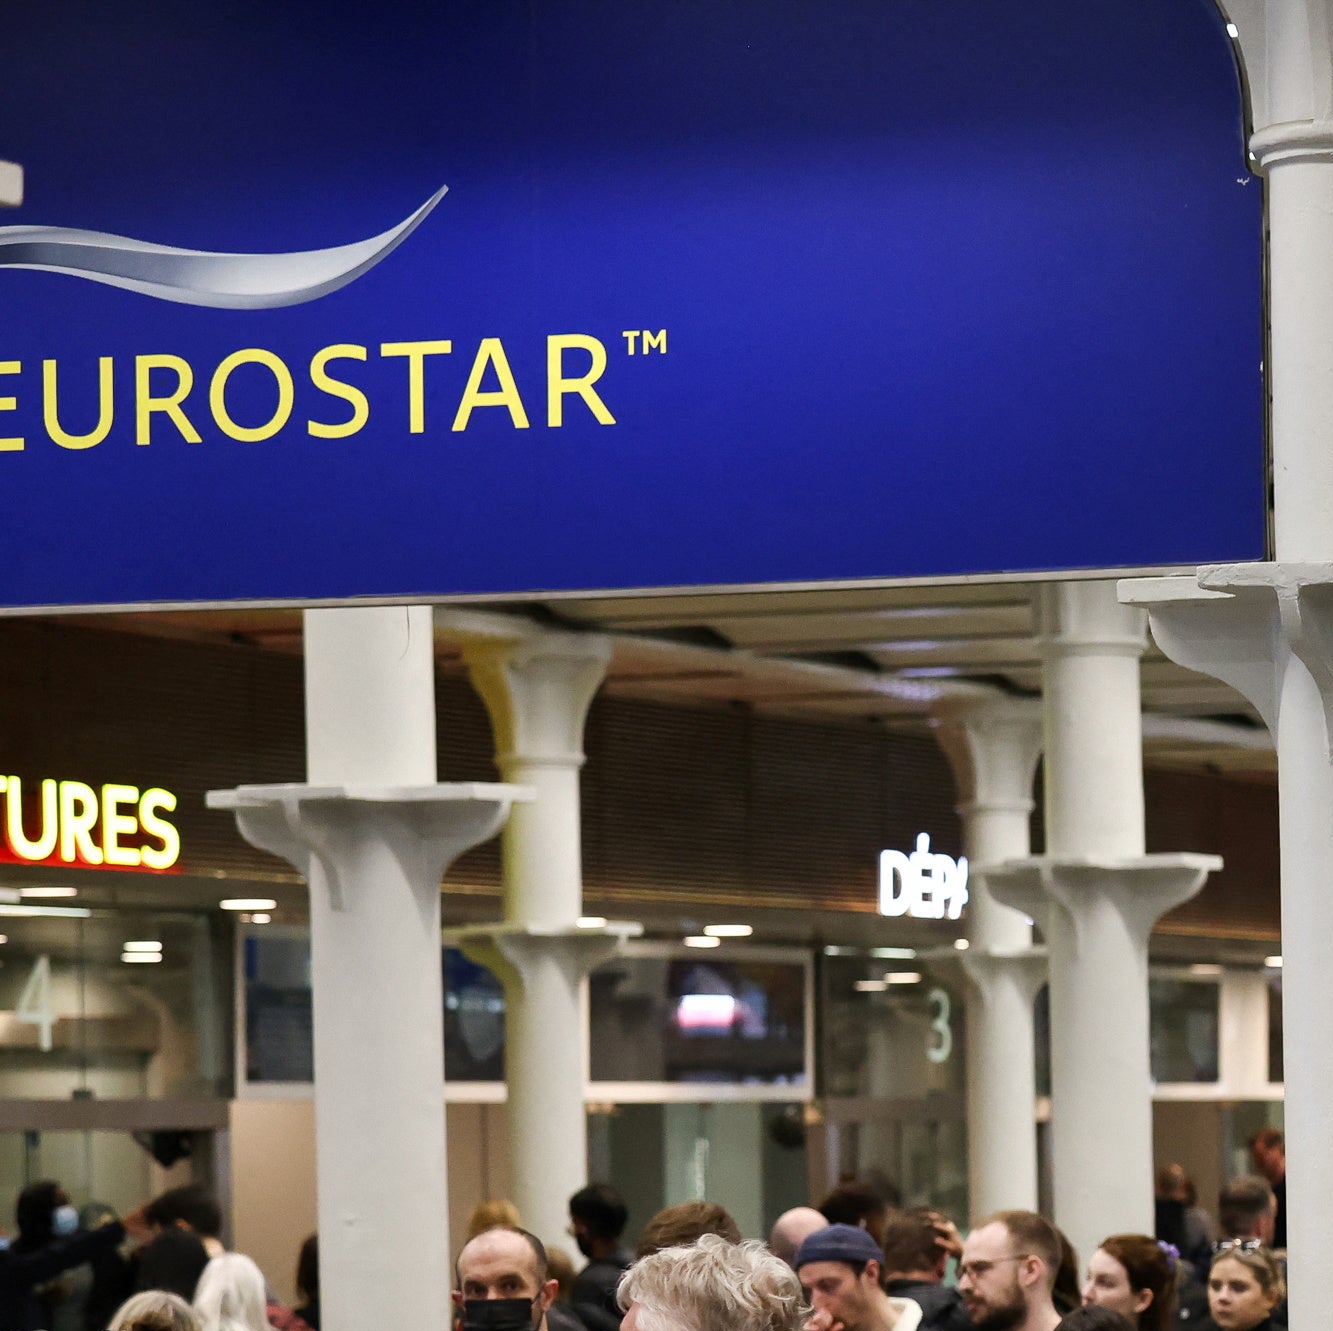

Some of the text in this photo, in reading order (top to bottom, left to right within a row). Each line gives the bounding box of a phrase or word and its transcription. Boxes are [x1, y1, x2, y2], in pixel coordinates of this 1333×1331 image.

[0, 774, 180, 870] URES
[17, 954, 55, 1051] 4
[926, 988, 953, 1063] 3
